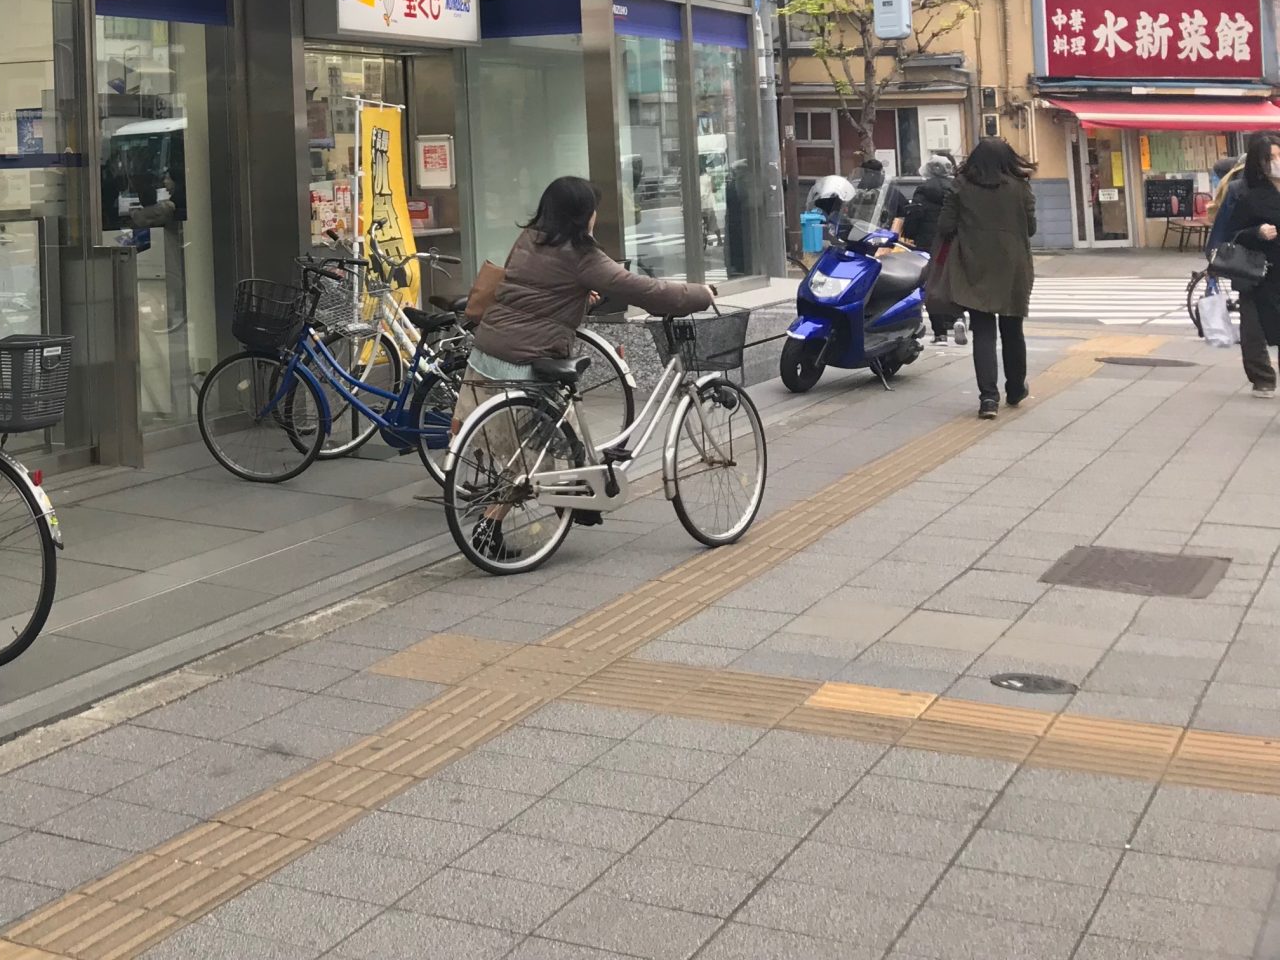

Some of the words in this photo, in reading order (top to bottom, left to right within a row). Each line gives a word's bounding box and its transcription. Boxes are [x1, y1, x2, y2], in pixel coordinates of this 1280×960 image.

[1051, 8, 1086, 33] 中華
[1053, 35, 1087, 57] 料理
[1093, 9, 1254, 62] 水新菜館
